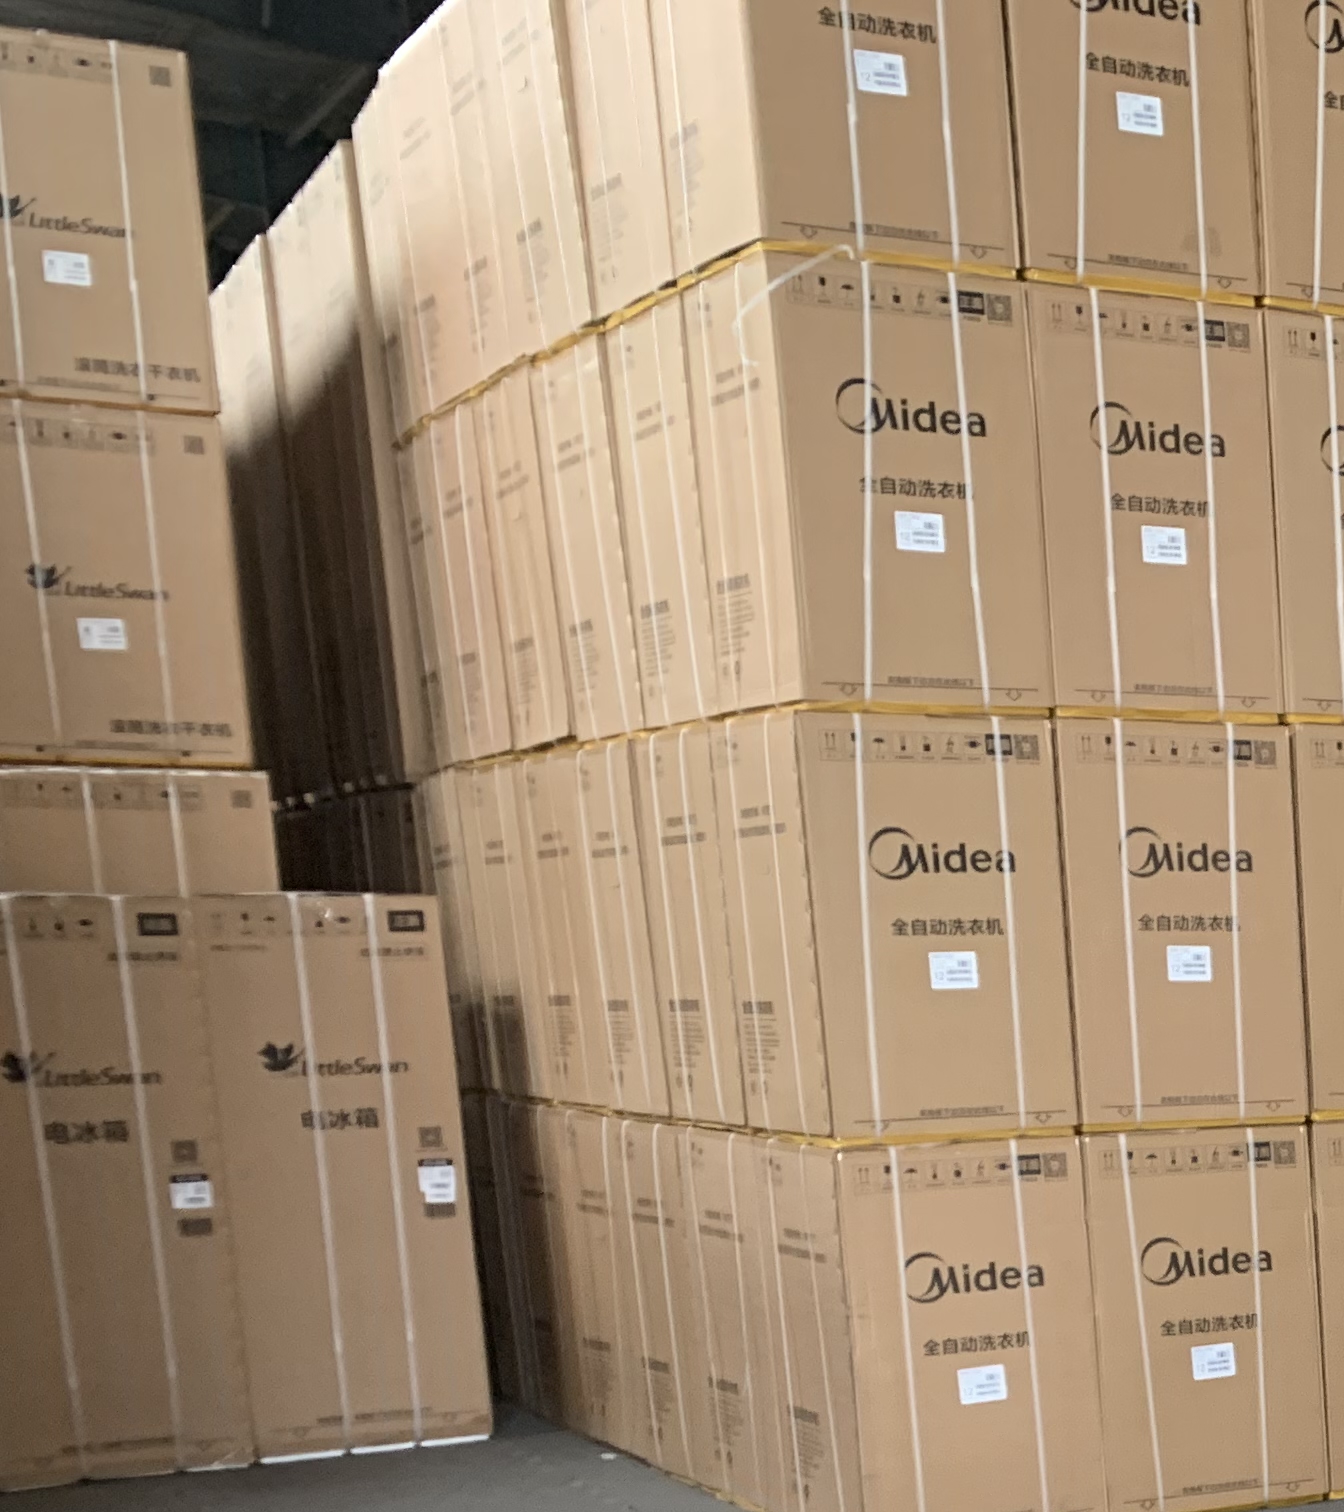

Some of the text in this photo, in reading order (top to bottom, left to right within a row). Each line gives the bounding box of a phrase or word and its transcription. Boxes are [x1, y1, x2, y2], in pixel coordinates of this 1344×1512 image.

[1086, 52, 1190, 87] 全自动洗衣机
[836, 378, 987, 437] Midea
[1090, 401, 1226, 457] Midea
[869, 826, 1016, 881] Midea
[1118, 826, 1253, 878] Midea
[891, 917, 1004, 936] 全自动洗衣机
[905, 1252, 1045, 1303] Midea
[1141, 1237, 1273, 1286] Midea
[923, 1330, 1031, 1356] 全自动洗衣机
[1160, 1313, 1258, 1337] 全自动洗衣机
